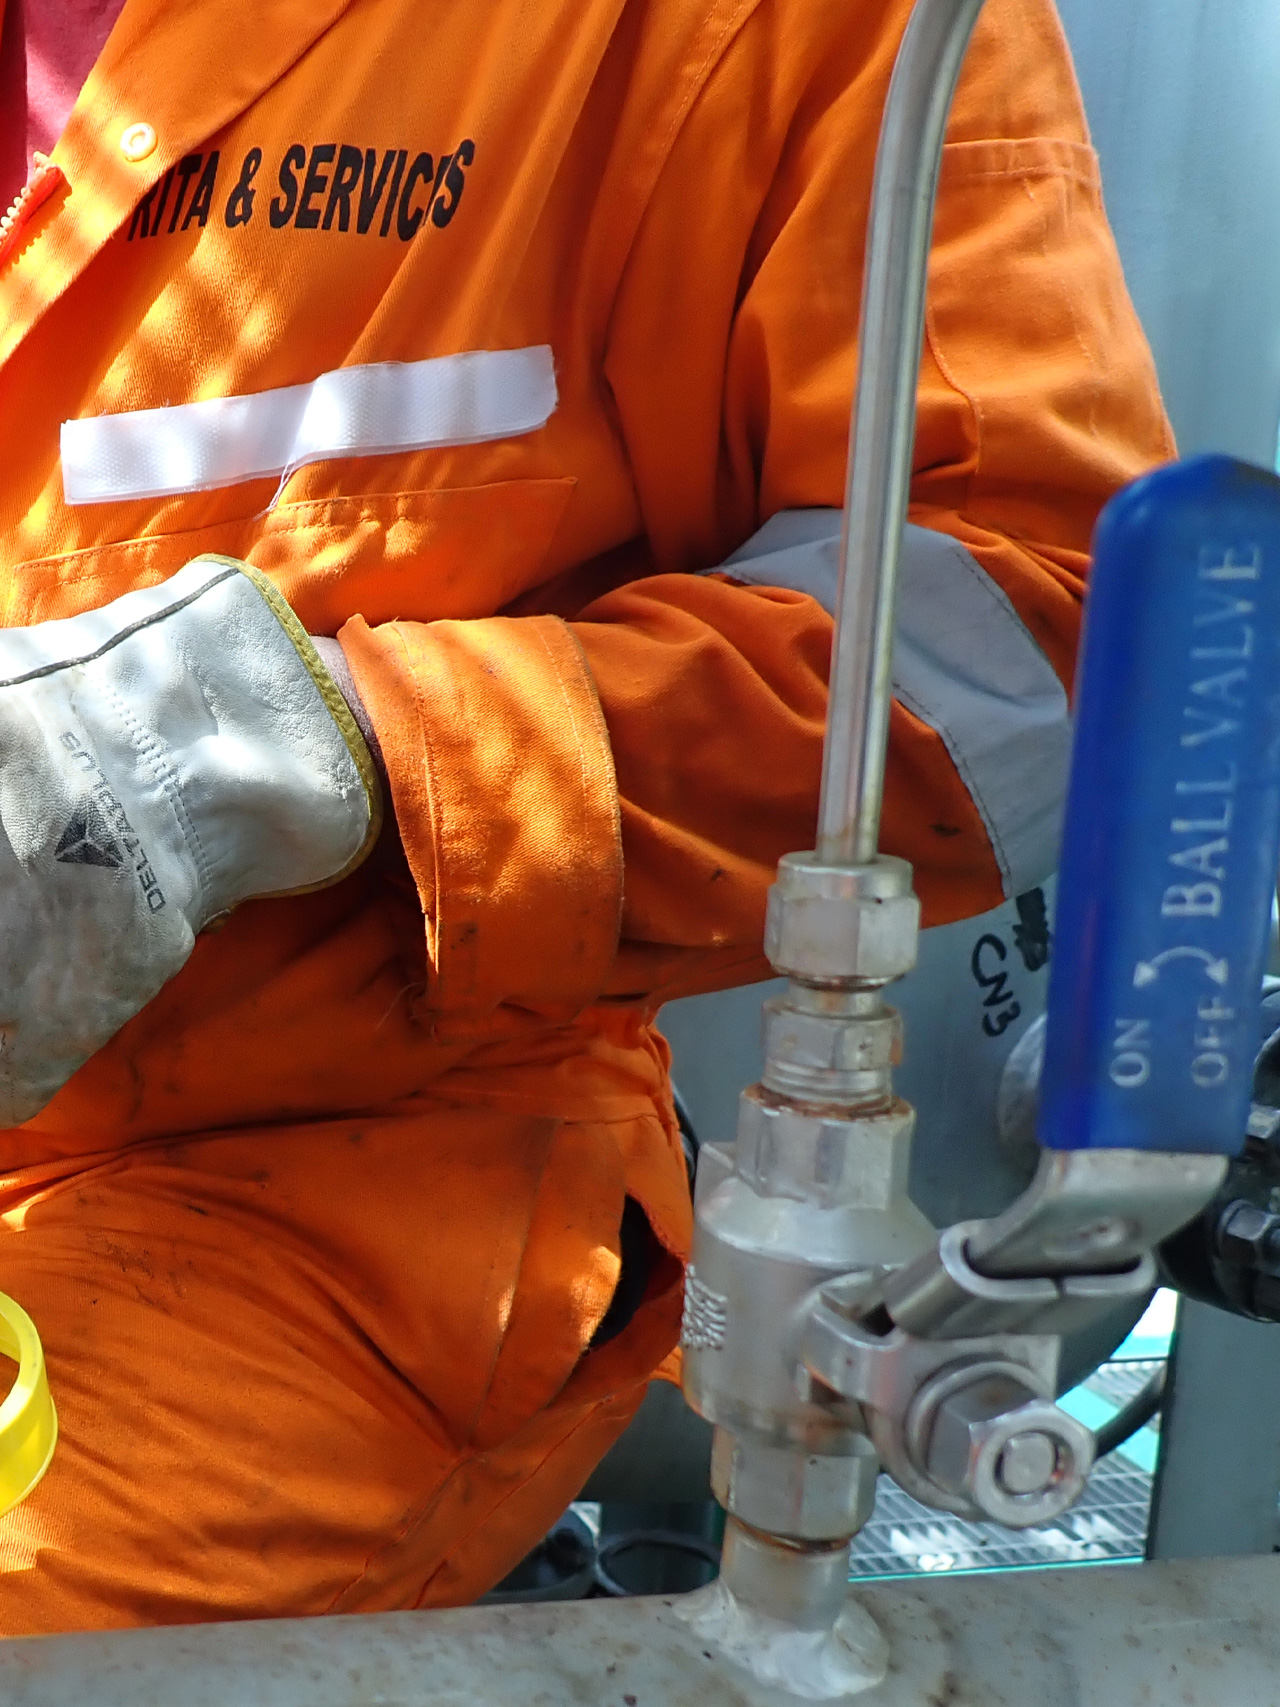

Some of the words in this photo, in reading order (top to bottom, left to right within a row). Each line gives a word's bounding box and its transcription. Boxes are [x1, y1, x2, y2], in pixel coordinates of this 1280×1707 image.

[224, 147, 262, 229] &
[1180, 544, 1262, 747] VALVE
[1160, 761, 1238, 917] BALL
[972, 933, 1022, 1038] CN3
[1109, 1017, 1151, 1088] ON
[1192, 996, 1234, 1088] OFF
